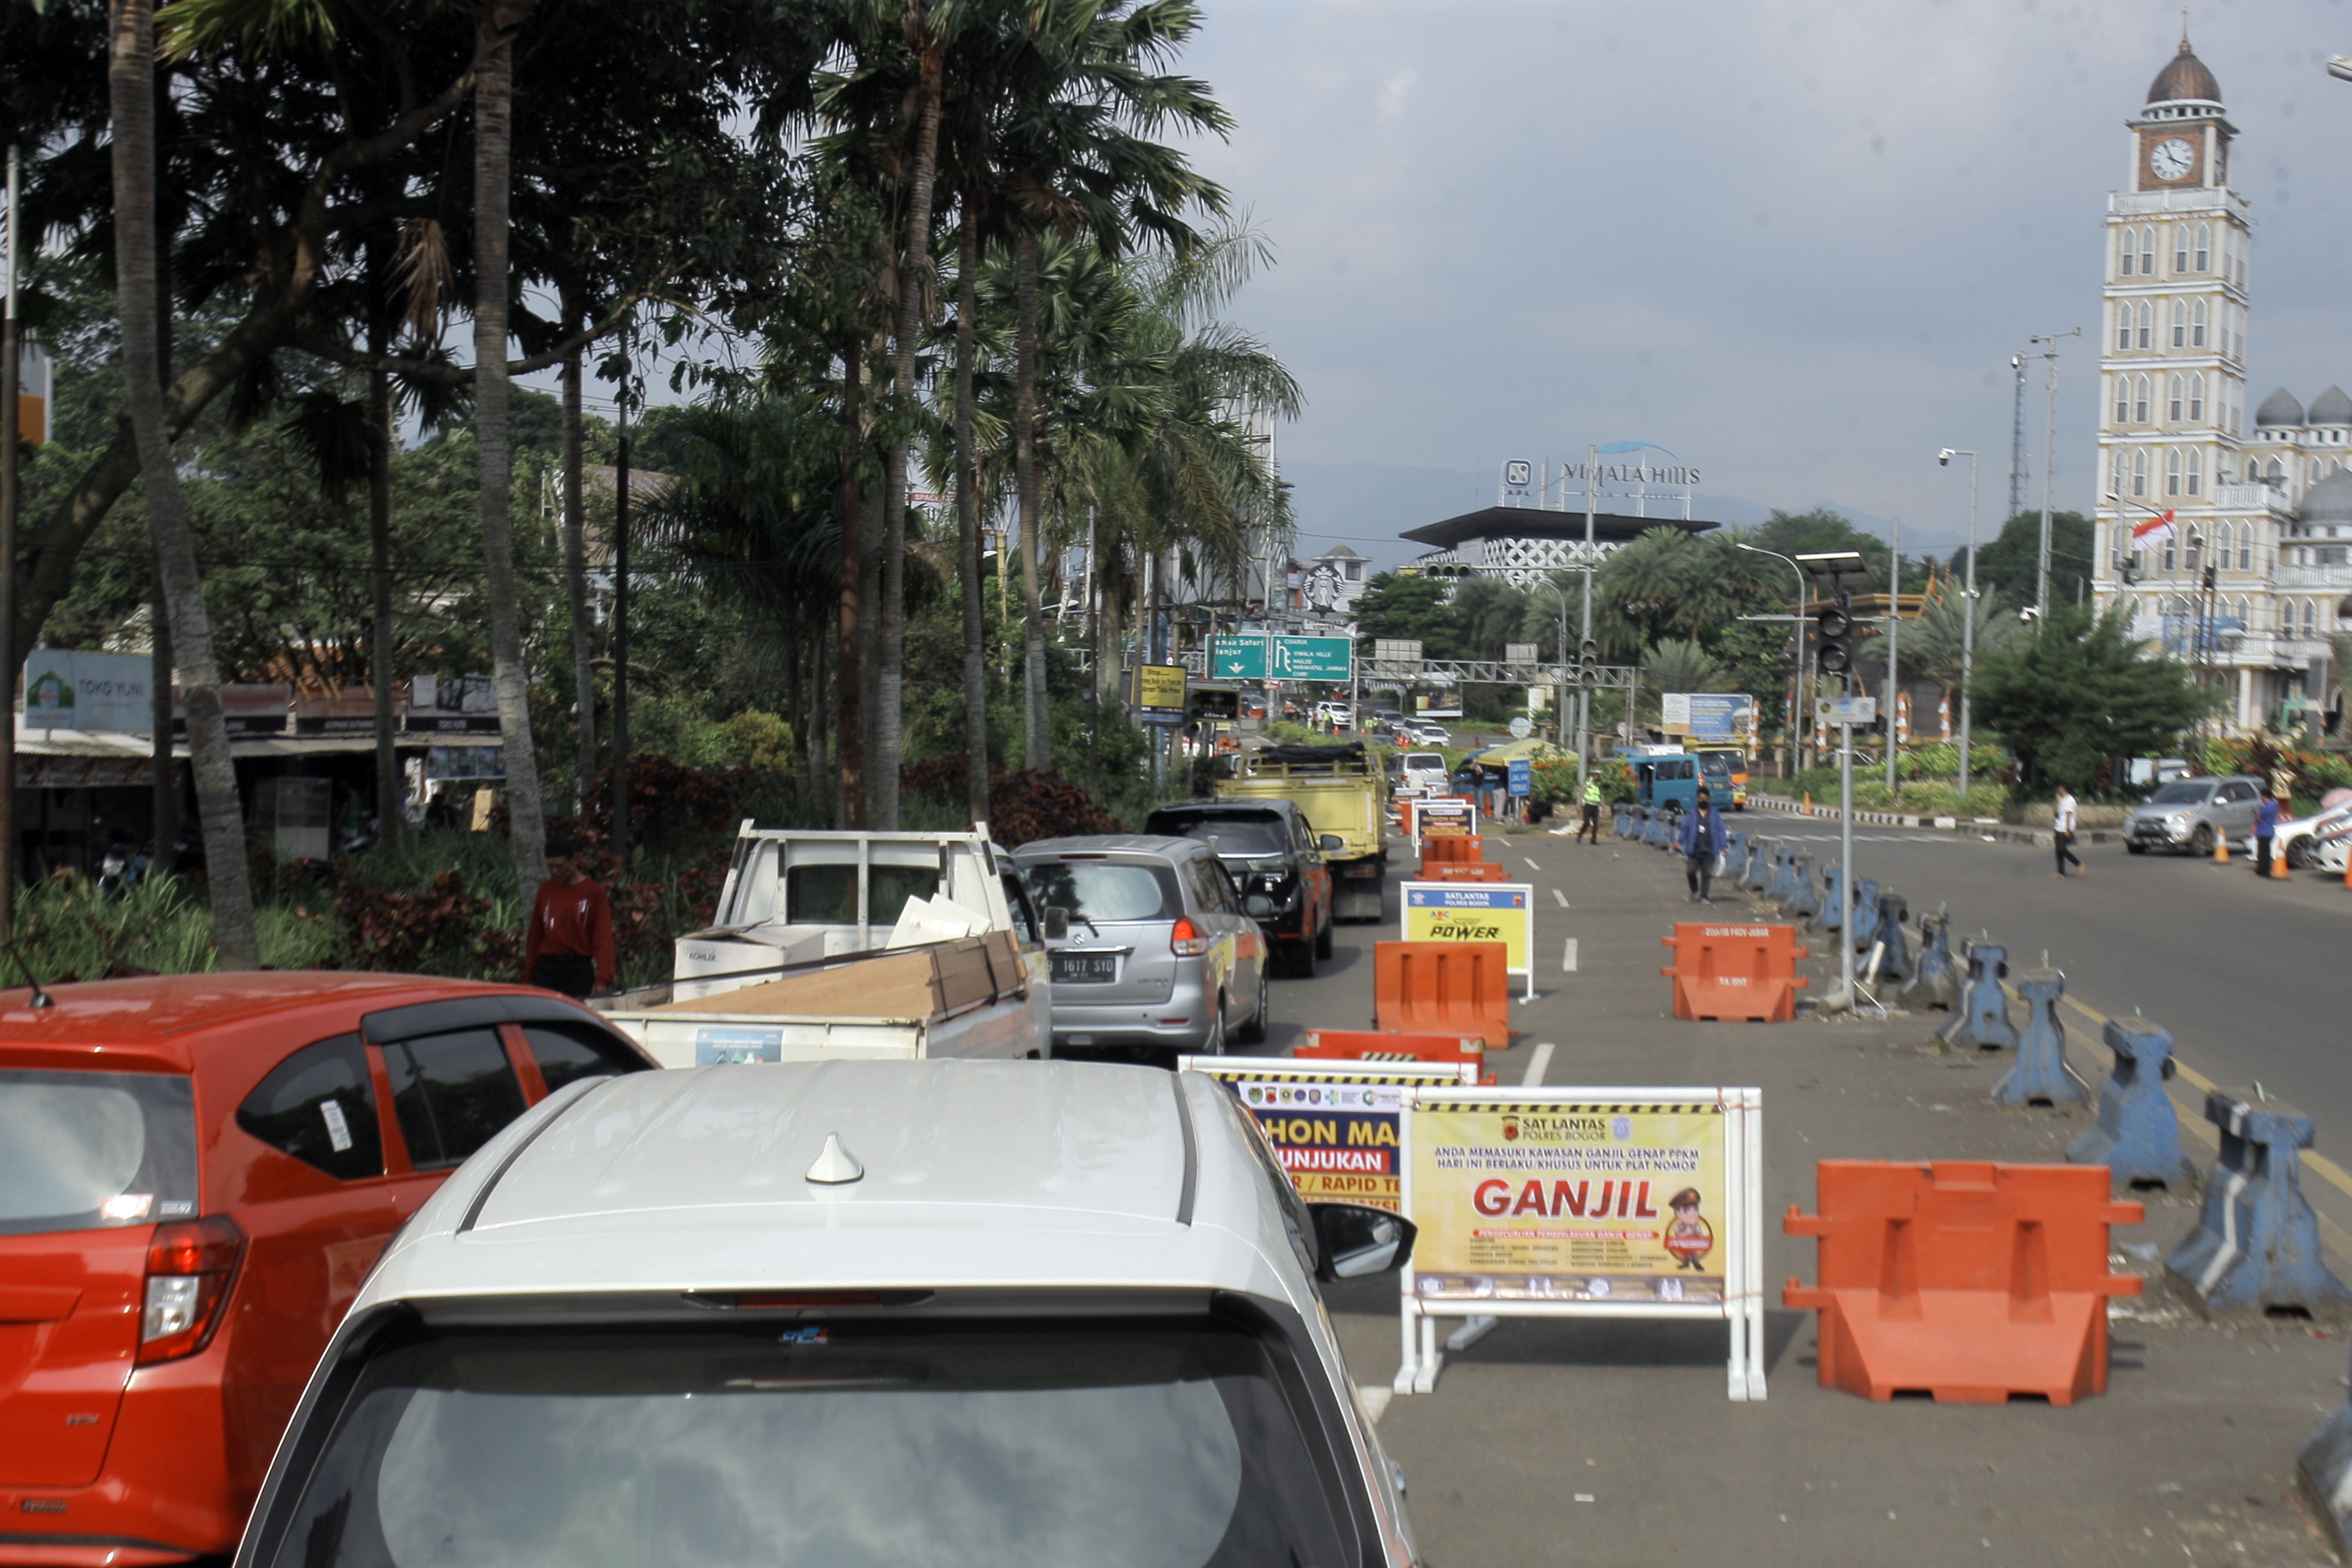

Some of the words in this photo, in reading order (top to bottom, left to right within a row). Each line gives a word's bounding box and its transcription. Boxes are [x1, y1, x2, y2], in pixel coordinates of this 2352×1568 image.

[1652, 466, 1700, 485] HILLS
[1215, 648, 1242, 656] ianjur
[78, 679, 112, 696] TOKO
[115, 682, 144, 696] YUNI
[1444, 891, 1490, 900] SATLANTAS
[1429, 926, 1499, 941] POWER
[689, 952, 716, 961] KOHLER
[1063, 959, 1087, 972] 1617
[1523, 1118, 1547, 1131] SAT
[1552, 1119, 1606, 1131] LANTAS
[1265, 1119, 1337, 1144] HON
[1347, 1121, 1400, 1146] MA
[1523, 1130, 1562, 1141] POLRES
[1565, 1131, 1606, 1141] BOGOR
[1279, 1149, 1381, 1171] UNJUKAN
[1435, 1146, 1466, 1158] ANDA
[1469, 1147, 1526, 1158] MEMASUKI
[1529, 1148, 1583, 1159] KAWASAN
[1586, 1148, 1625, 1159] GANJIL
[1628, 1149, 1666, 1160] GENAP
[1669, 1149, 1699, 1160] PPKM
[1438, 1158, 1464, 1169] HARI
[1466, 1159, 1483, 1169] INI
[1485, 1159, 1582, 1171] BERLAKU/KHUSUS
[1585, 1160, 1623, 1171] UNTUK
[1626, 1160, 1652, 1171] PLAT
[1655, 1161, 1697, 1171] NOMOR
[1322, 1177, 1377, 1191] RAPID
[1384, 1179, 1399, 1192] TE
[1473, 1179, 1658, 1219] GANJIL
